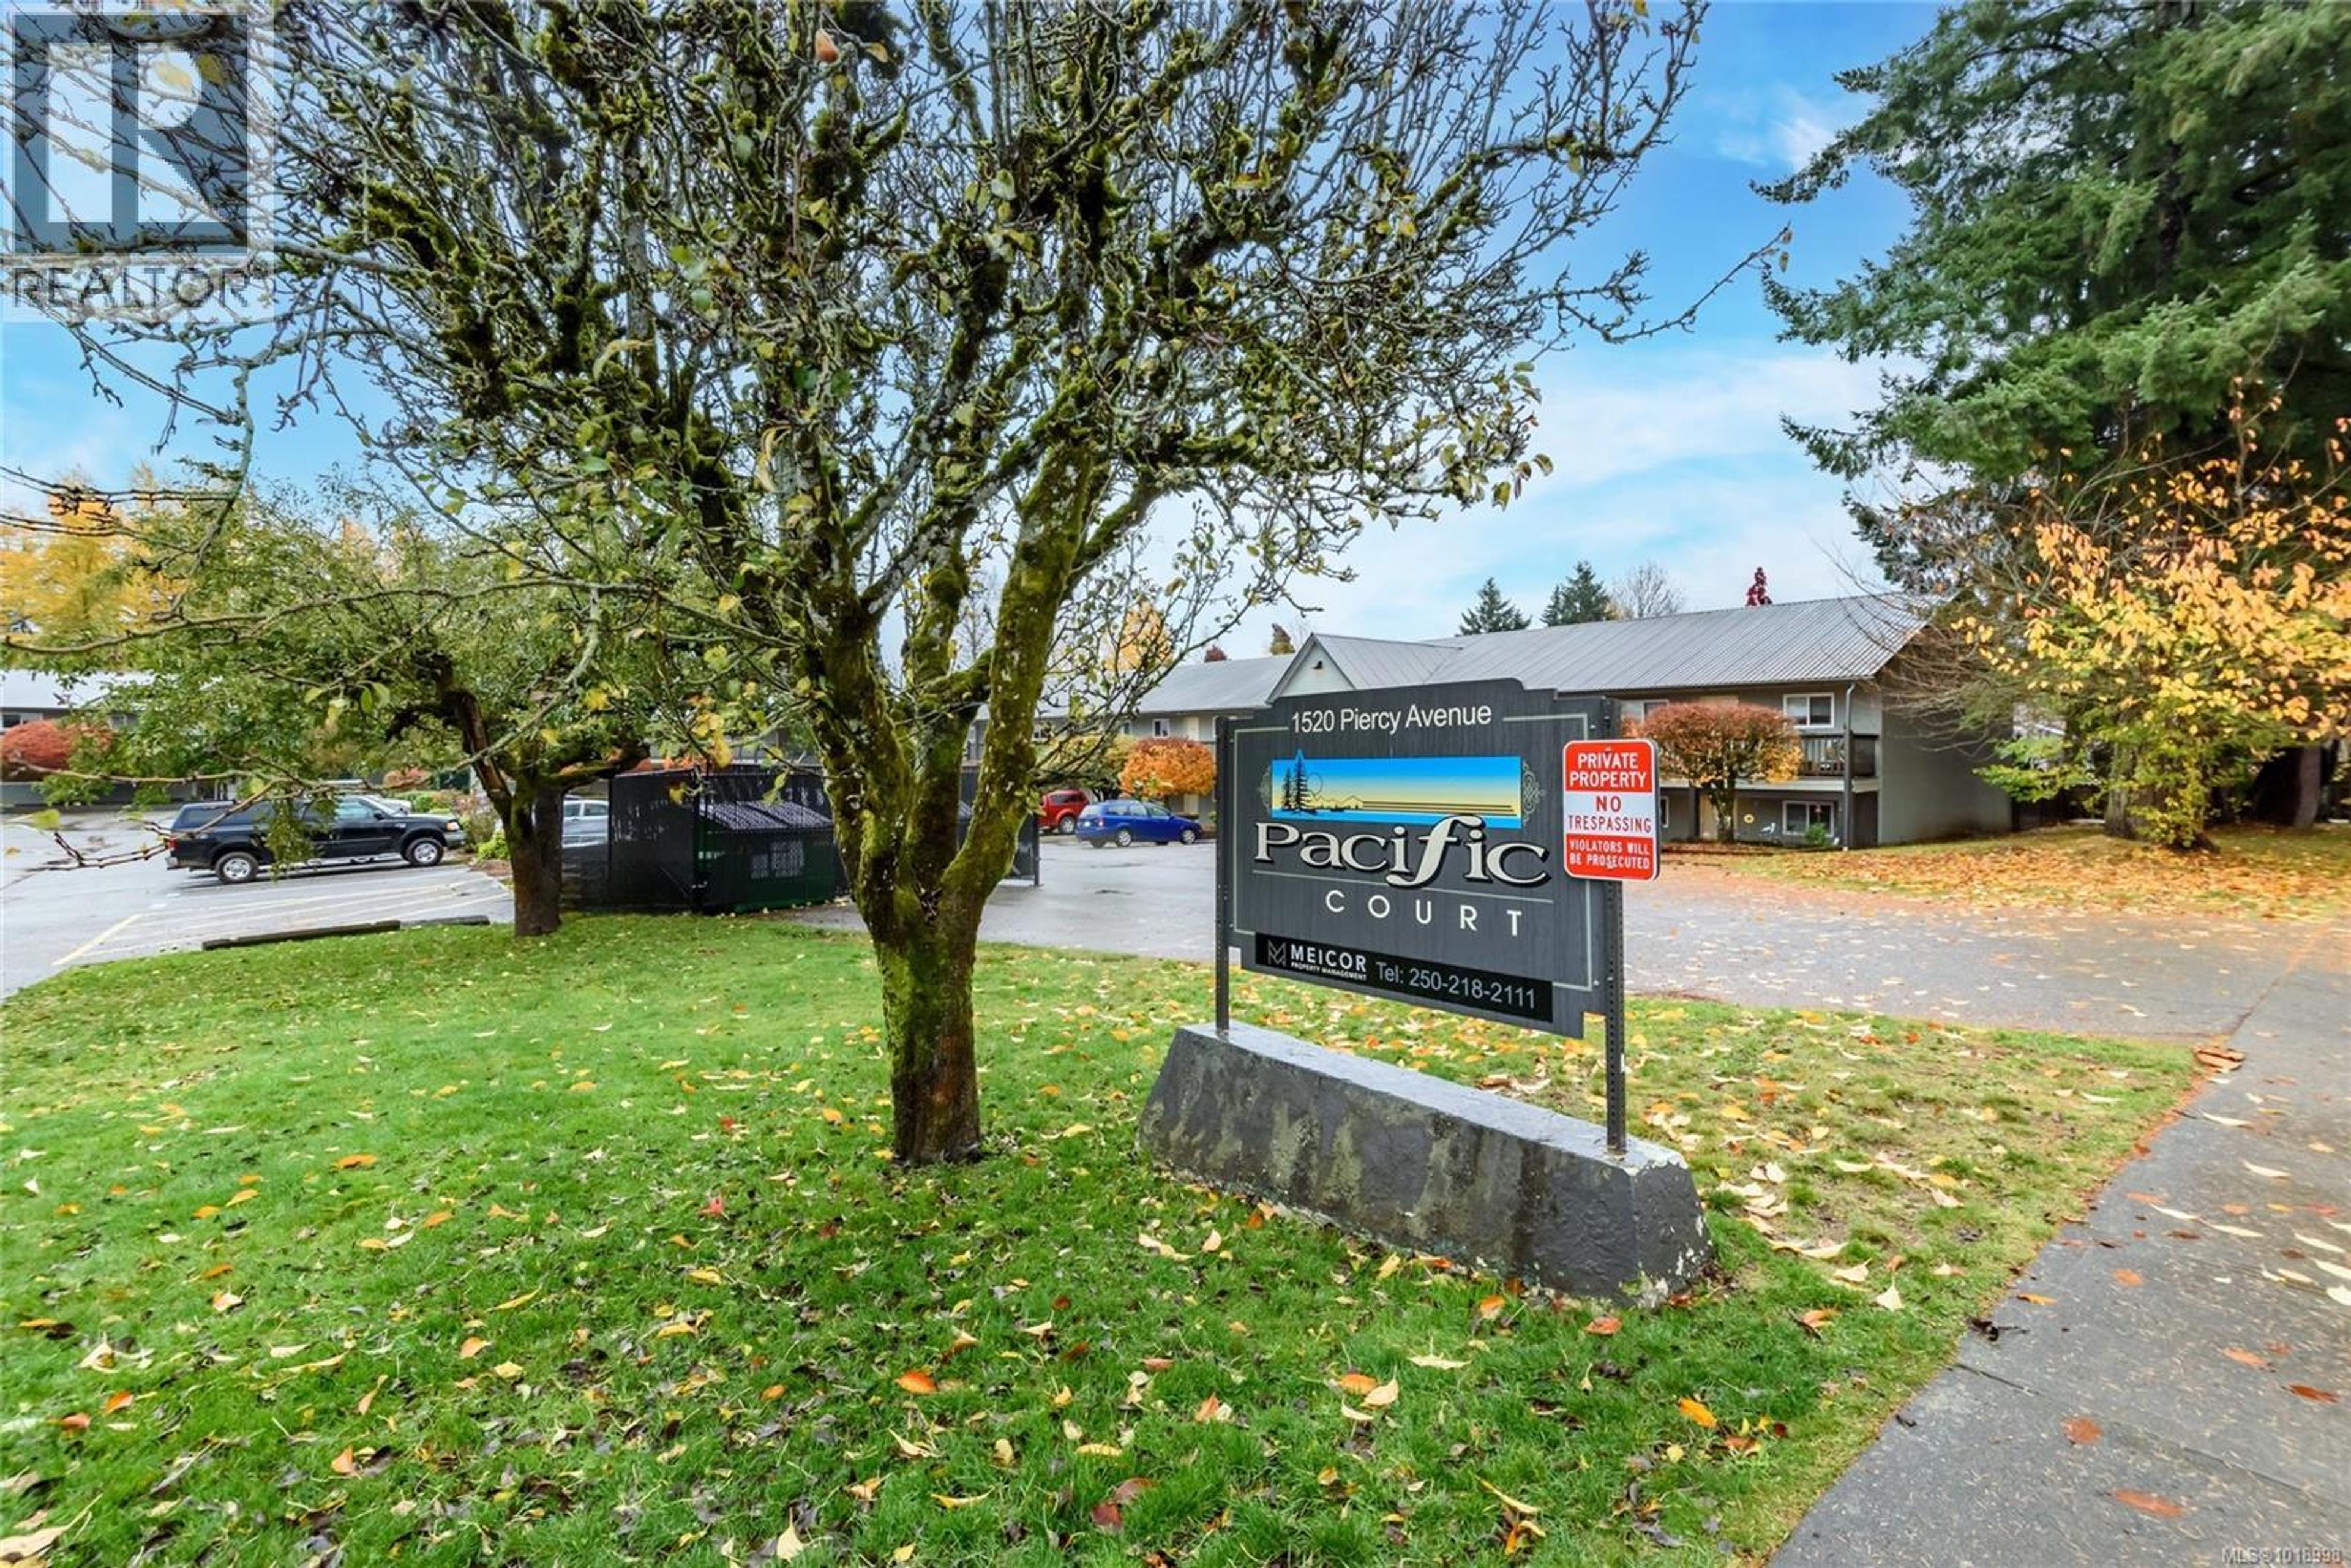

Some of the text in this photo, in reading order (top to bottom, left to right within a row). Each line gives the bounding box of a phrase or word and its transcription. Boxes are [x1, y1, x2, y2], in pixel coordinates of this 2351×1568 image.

[1292, 704, 1492, 735] 1520 Piercy Avenue
[1578, 752, 1638, 769] PRIVATE
[1570, 771, 1646, 788] PROPERTY
[1595, 795, 1622, 812] NO
[1568, 815, 1652, 833] TRESPASSING
[1253, 814, 1550, 888] Pacific
[1569, 839, 1650, 855] VIOLATORS WILL
[1569, 853, 1650, 869] BE PROSECUTED
[1325, 890, 1523, 937] COURT
[1291, 943, 1367, 973] MEICOR
[1291, 962, 1367, 980] PROPERTY MANAGEMENT
[1376, 961, 1535, 1009] Tel: 250-218-2111
